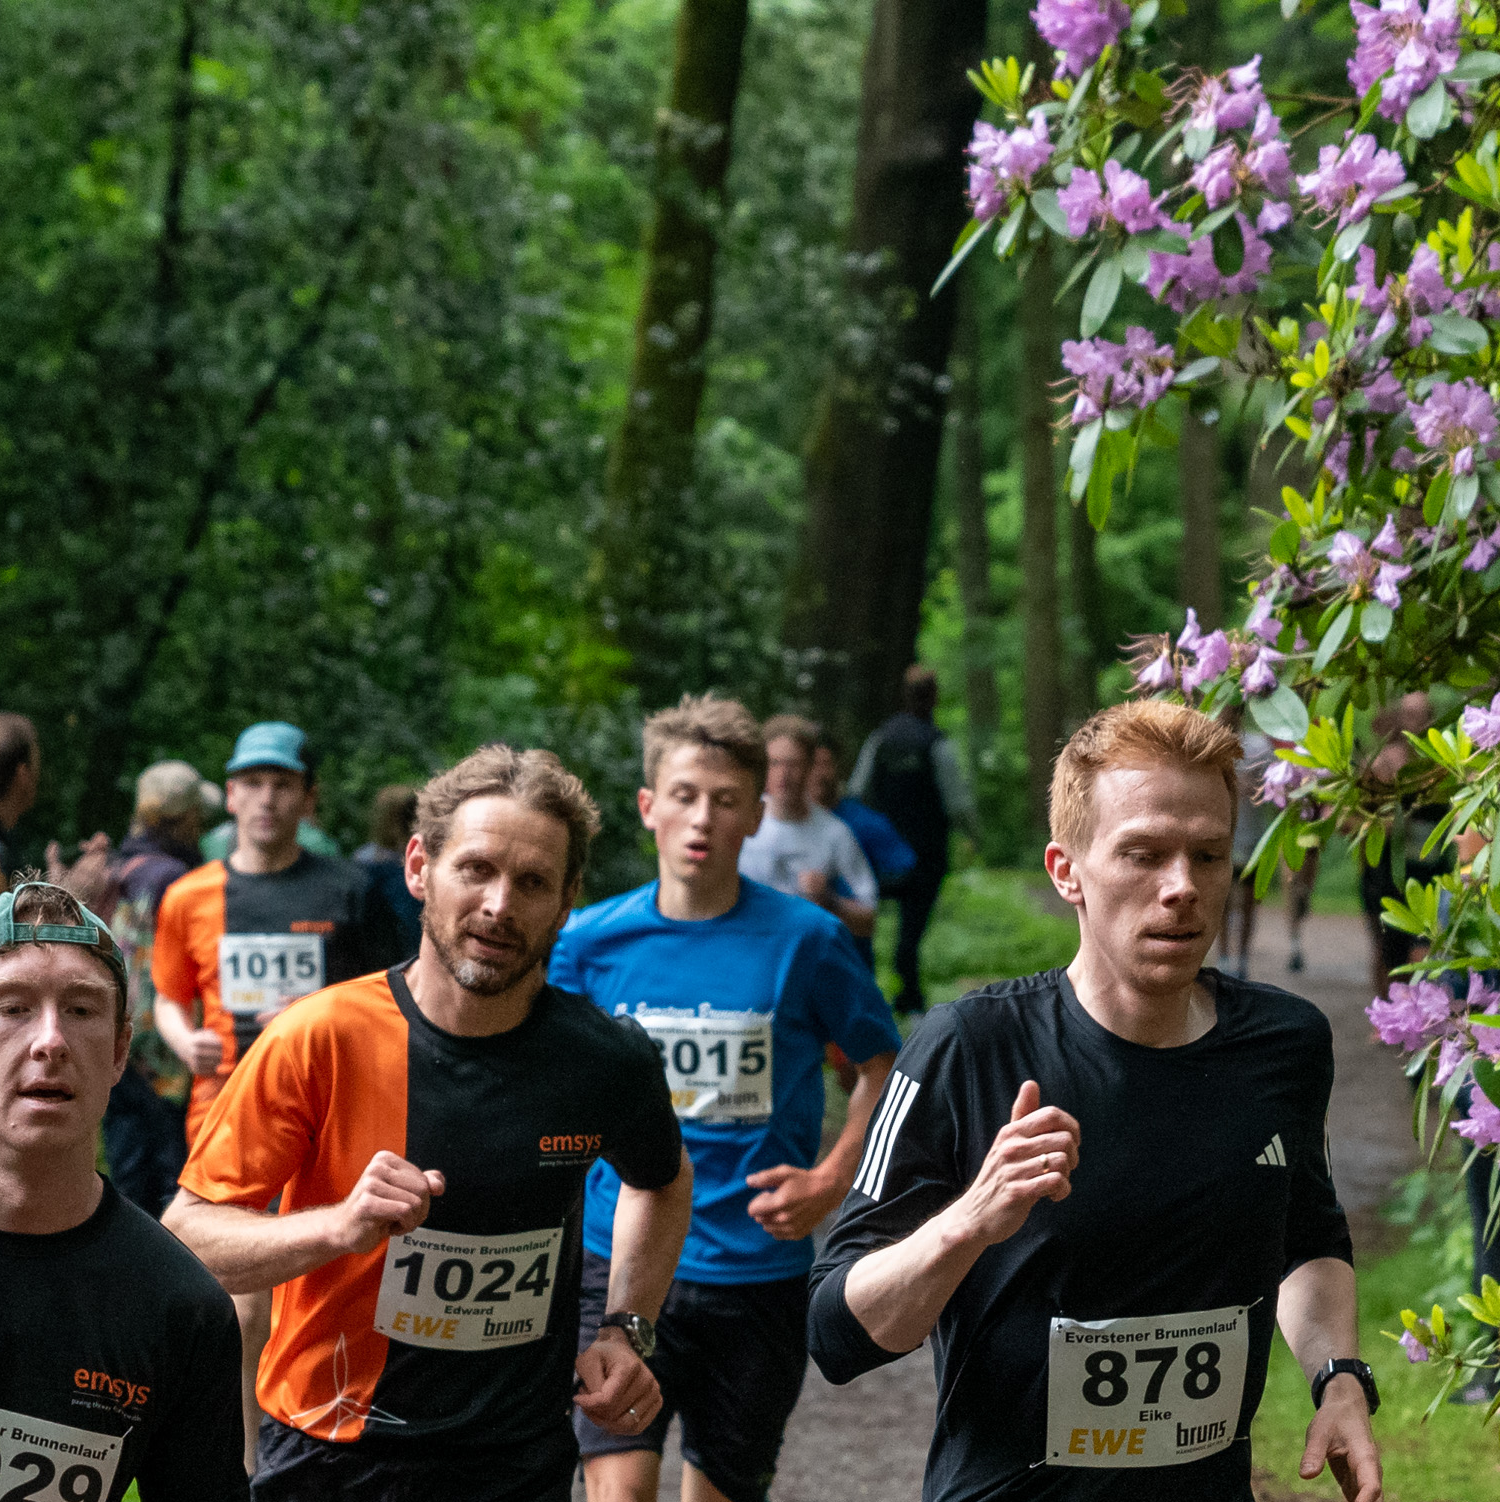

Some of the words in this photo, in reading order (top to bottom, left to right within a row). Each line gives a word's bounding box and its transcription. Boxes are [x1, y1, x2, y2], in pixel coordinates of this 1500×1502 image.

[226, 951, 317, 979] 1015
[539, 1134, 602, 1157] emsys
[402, 1235, 477, 1255] Everstener
[479, 1238, 551, 1255] Brunnenlauf
[393, 1251, 550, 1303] 1024
[443, 1305, 494, 1316] Edward
[392, 1312, 460, 1340] EWE
[482, 1317, 535, 1338] bruns
[1064, 1331, 1151, 1344] Everstener
[1154, 1318, 1238, 1341] Brunnenlauf
[74, 1368, 151, 1408] emsys
[1082, 1341, 1222, 1407] 878
[1138, 1410, 1172, 1422] Eike
[10, 1426, 109, 1462] Brunnenlauf
[1067, 1427, 1147, 1456] EWE
[1176, 1420, 1228, 1448] bruns
